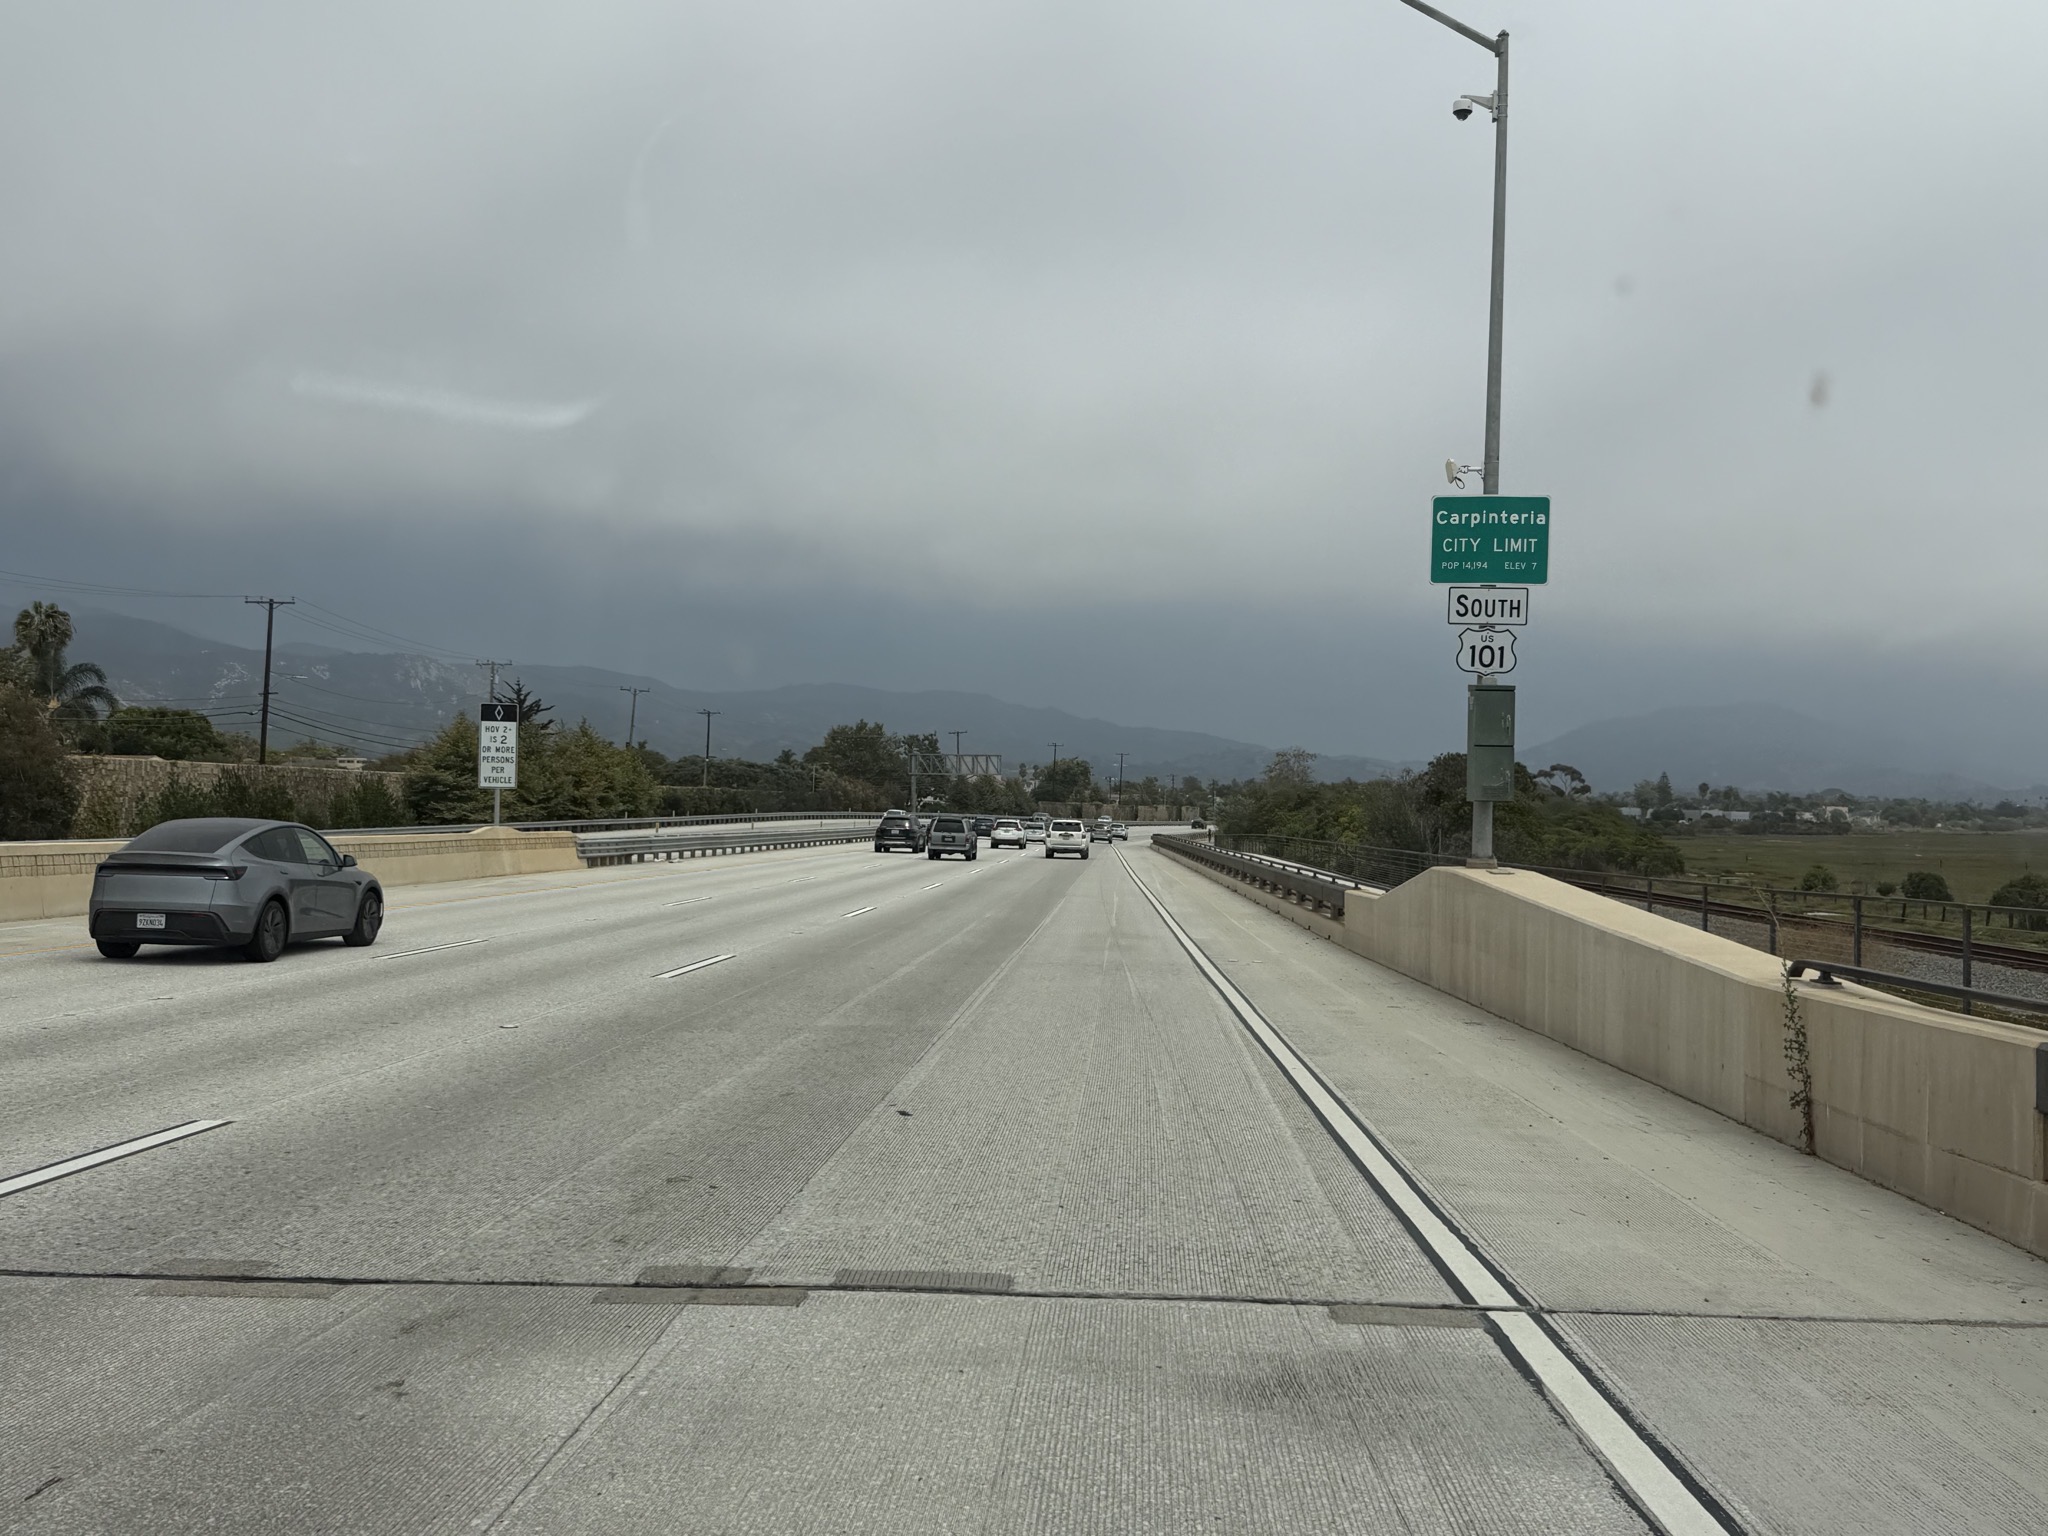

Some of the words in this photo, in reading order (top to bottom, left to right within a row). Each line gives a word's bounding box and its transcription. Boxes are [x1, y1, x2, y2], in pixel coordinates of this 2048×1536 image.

[1436, 510, 1546, 528] Carpinteria
[1442, 538, 1481, 552] CITY
[1493, 538, 1538, 552] LIMIT
[1441, 562, 1460, 570] POP
[1462, 562, 1488, 570] 14,194
[1504, 562, 1526, 570] ELEV
[1531, 562, 1537, 570] 7
[1455, 594, 1521, 618] SOUTH
[1480, 635, 1494, 643] US
[1469, 645, 1505, 668] 101
[500, 735, 507, 745] 2
[495, 746, 515, 754] MORE
[482, 756, 515, 764] PERSONS
[491, 766, 505, 774] PER
[483, 776, 512, 784] VEHICLE
